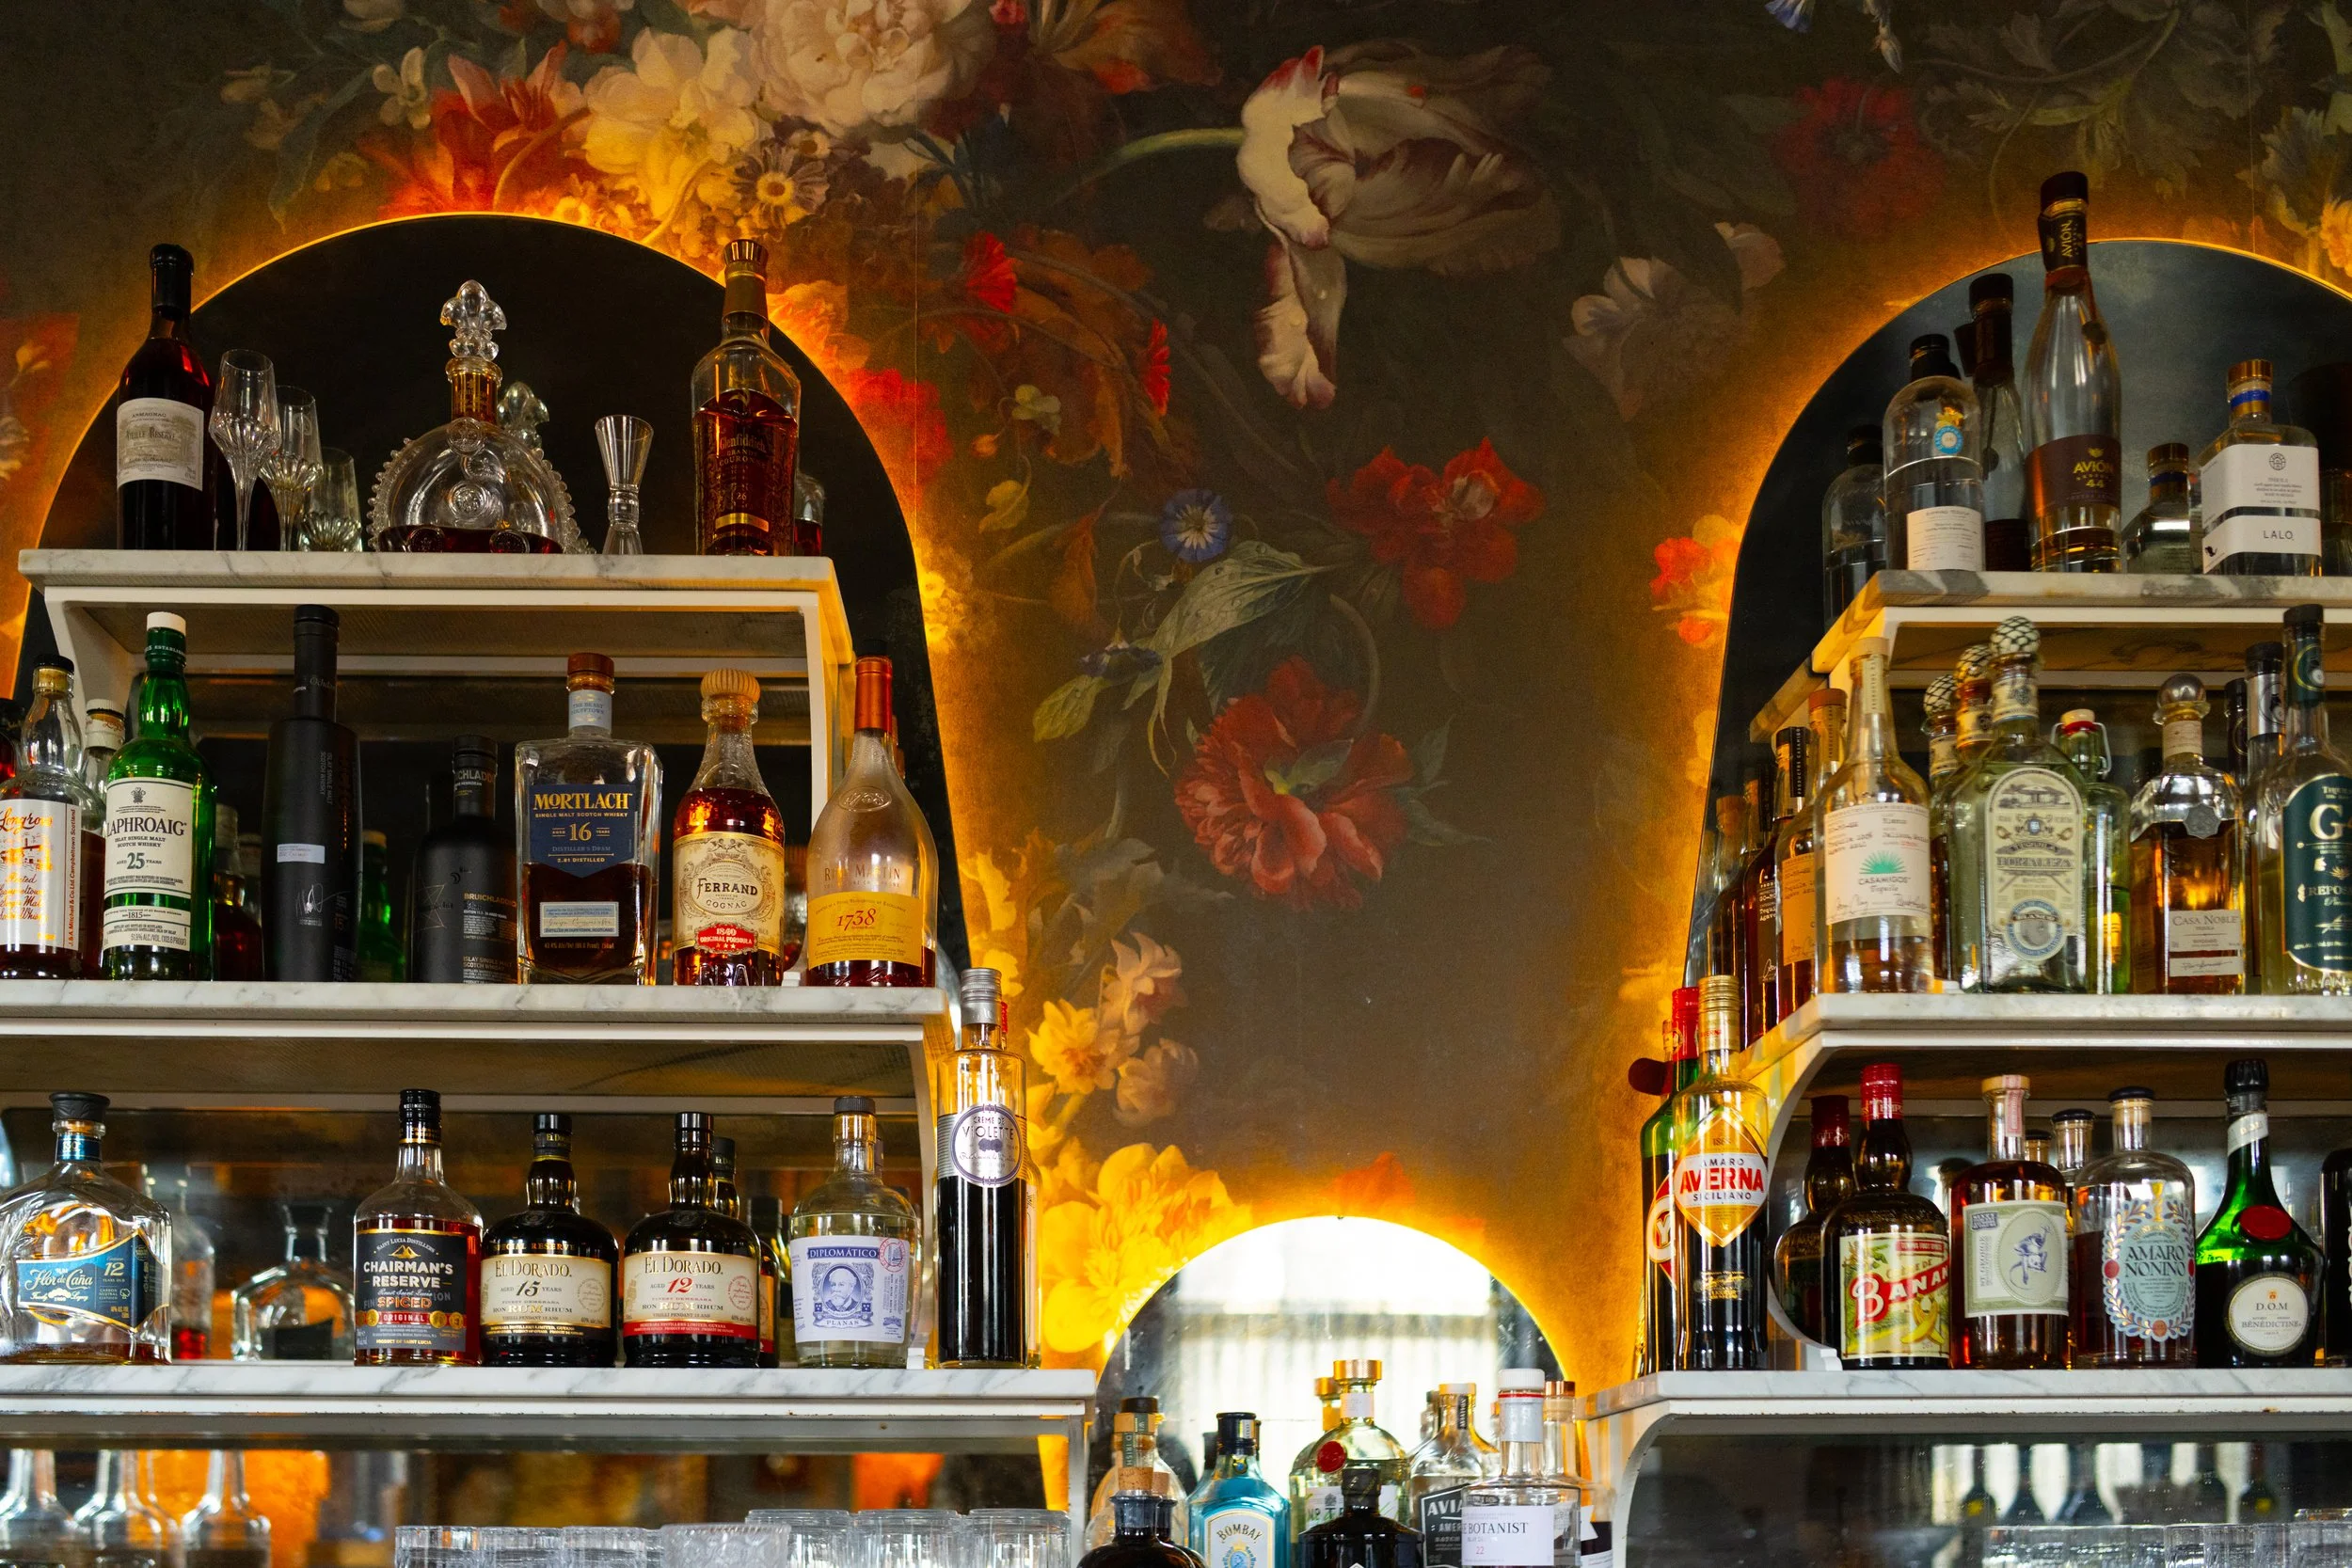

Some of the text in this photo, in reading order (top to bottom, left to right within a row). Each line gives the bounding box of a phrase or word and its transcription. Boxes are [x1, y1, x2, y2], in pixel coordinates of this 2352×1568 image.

[2263, 531, 2294, 540] LALO
[533, 793, 629, 811] MORTLACH
[569, 822, 592, 841] 16
[127, 852, 146, 869] 25
[855, 863, 901, 880] MTIN
[696, 878, 758, 899] FERRAND
[1858, 878, 1908, 886] CASAMIGOS
[706, 899, 748, 910] COGNAC
[836, 908, 877, 931] 1738
[2172, 914, 2239, 927] CASA NOBLE
[726, 936, 753, 944] FORMULA
[961, 1125, 1014, 1140] VIOLETTE
[1679, 1167, 1765, 1195] AVERNA
[1692, 1192, 1752, 1202] SICILIANO
[376, 1239, 390, 1250] SAINT
[406, 1237, 436, 1253] DISTILLERS
[809, 1247, 878, 1258] DIPLOMÁTICO
[2126, 1244, 2185, 1262] AMARO
[103, 1262, 125, 1276] 12
[363, 1260, 454, 1275] CHAIRMAN'S
[495, 1260, 508, 1278] EL
[644, 1257, 660, 1275] EL
[2124, 1260, 2187, 1278] NONINO
[24, 1268, 93, 1291] Flor de Caña
[373, 1275, 441, 1289] RESERVE
[666, 1276, 693, 1293] 12
[516, 1280, 541, 1297] 15
[376, 1296, 433, 1308] SPICED
[508, 1305, 543, 1314] RUM
[660, 1302, 695, 1310] RUM
[383, 1314, 425, 1323] ORIGINAL
[2241, 1320, 2300, 1328] BÉNÉDICTINE
[1216, 1523, 1263, 1541] BOMBAY
[1468, 1522, 1529, 1534] BOTANIST
[1475, 1545, 1485, 1555] 22
